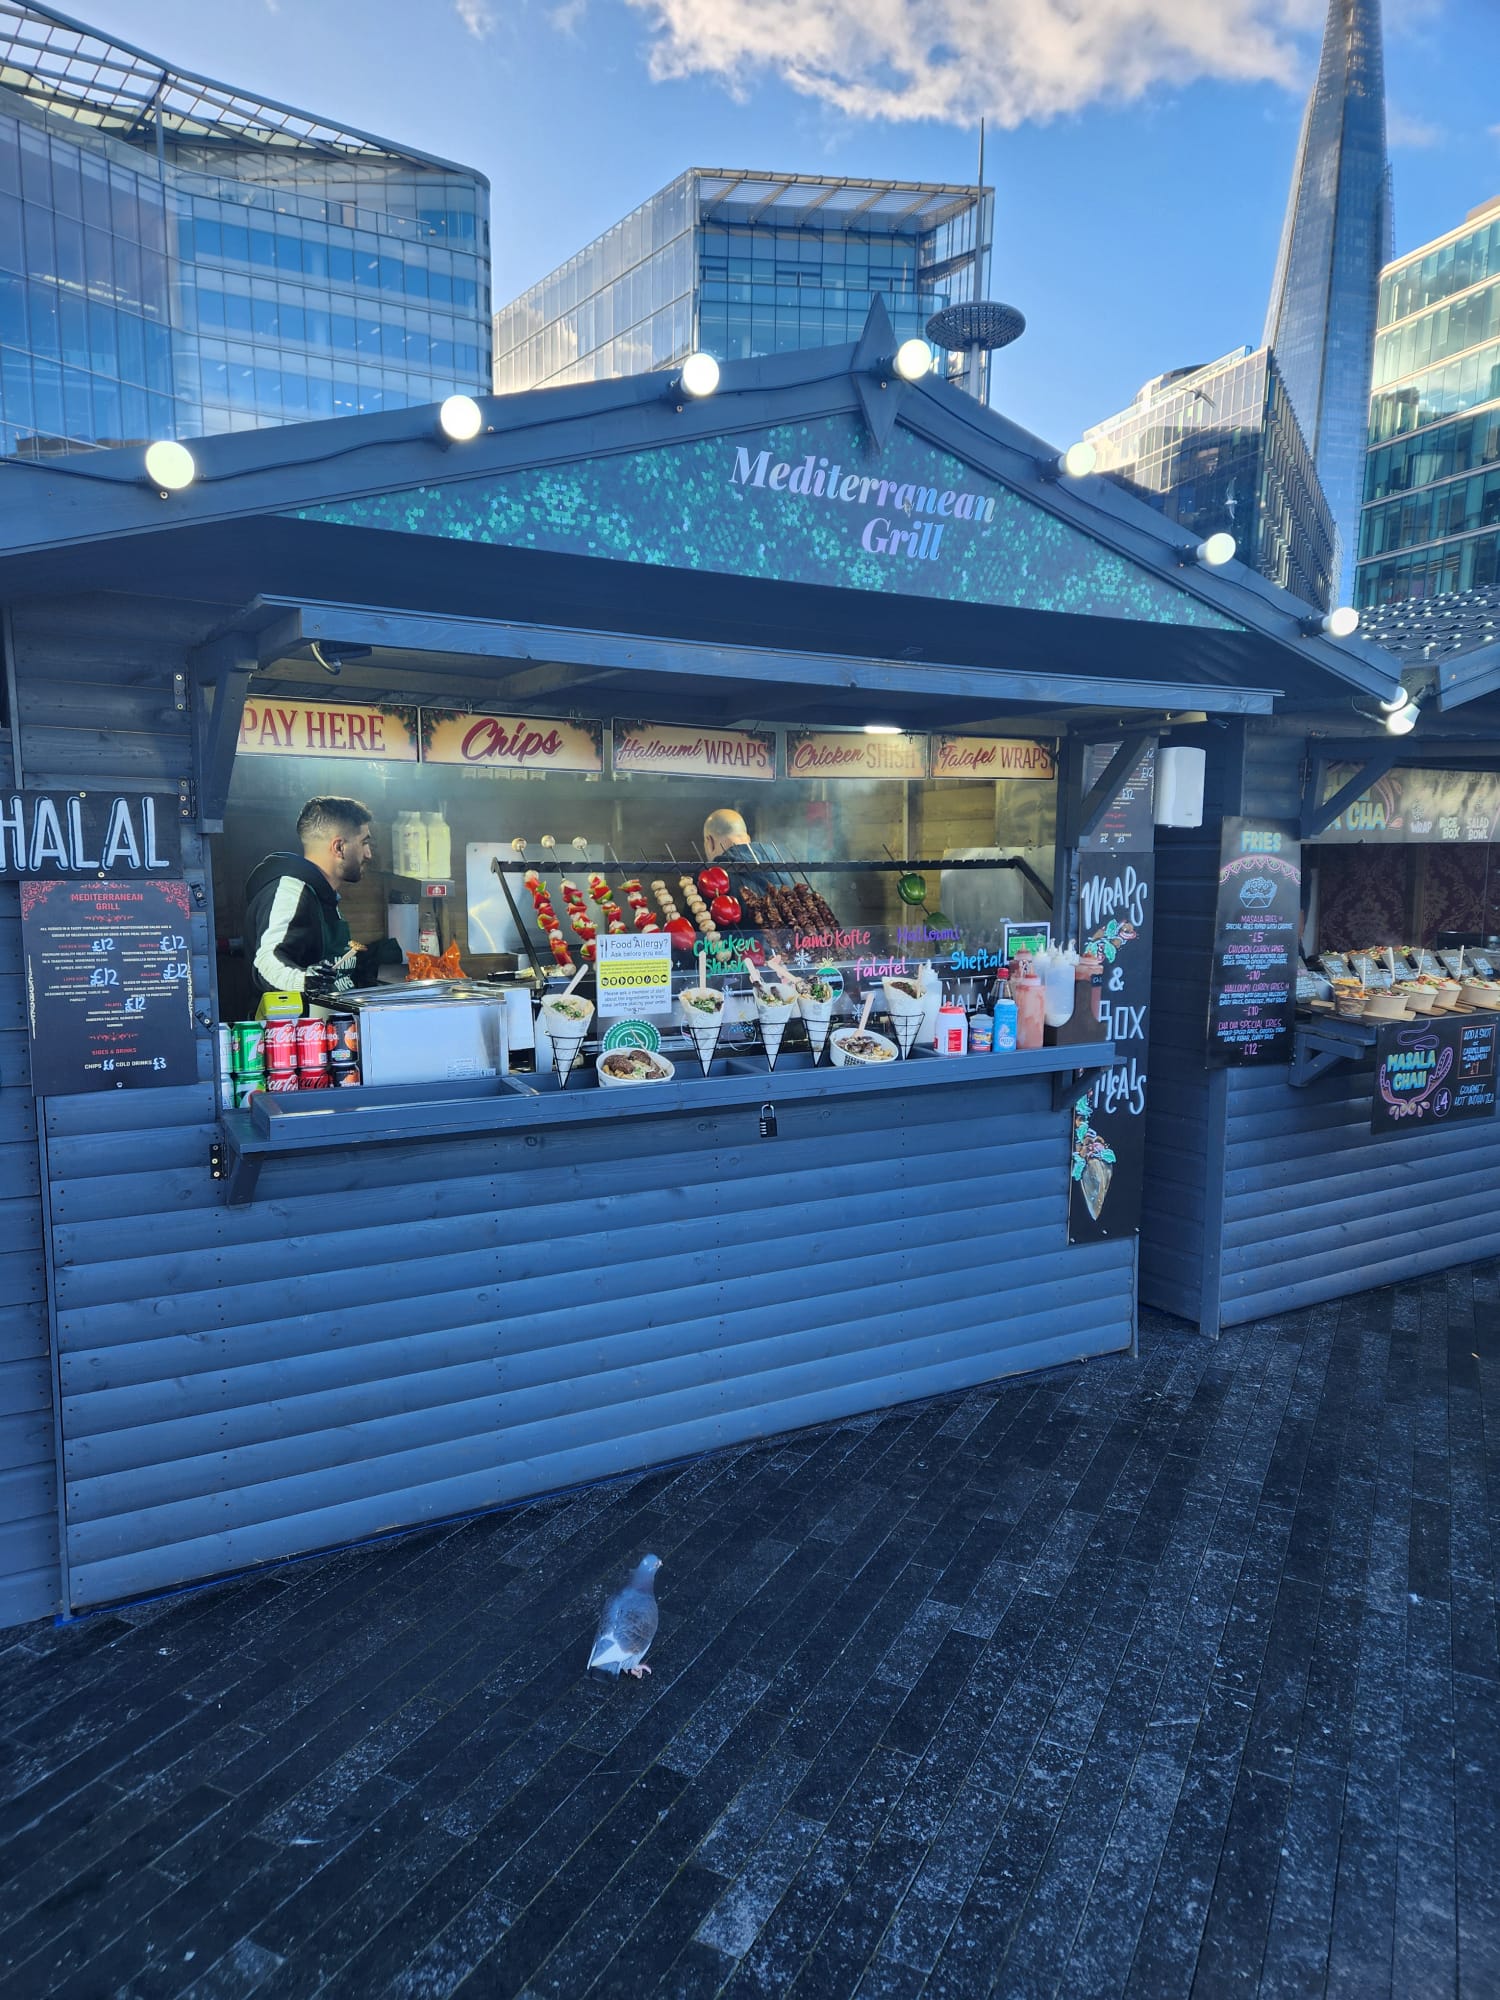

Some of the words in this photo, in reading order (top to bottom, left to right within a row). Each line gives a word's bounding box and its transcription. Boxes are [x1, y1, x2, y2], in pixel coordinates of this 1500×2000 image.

[728, 446, 996, 524] Mediterranean
[861, 517, 945, 561] Grill
[238, 705, 298, 747] PAY
[305, 709, 386, 752] HERE
[461, 717, 563, 763] Chips
[618, 738, 703, 761] Halloumi
[704, 739, 767, 768] WRAPS
[794, 742, 865, 769] Chicken
[866, 743, 916, 769] SHISH
[938, 744, 997, 770] Falafel
[1000, 745, 1049, 769] WRAPS
[0, 796, 170, 872] HALAL
[1241, 830, 1283, 853] FRIES
[70, 893, 144, 902] MEDITERRANEAN
[95, 903, 120, 911] GRILL
[1081, 866, 1147, 930] WRAPS
[91, 938, 116, 952] £12
[159, 935, 188, 951] £12
[610, 940, 632, 949] Food
[634, 938, 669, 950] Allergy?
[693, 934, 760, 957] Chicken
[794, 930, 832, 950] Lamb
[835, 929, 871, 949] Kofte
[90, 967, 120, 986] £12
[162, 963, 189, 980] £12
[853, 956, 909, 981] falafel
[1108, 966, 1125, 991] &
[124, 997, 147, 1012] £12
[942, 992, 991, 1012] HALA
[103, 1059, 115, 1071] £6
[152, 1057, 167, 1071] £3
[1387, 1050, 1436, 1072] MASALA
[1435, 1091, 1448, 1111] £4
